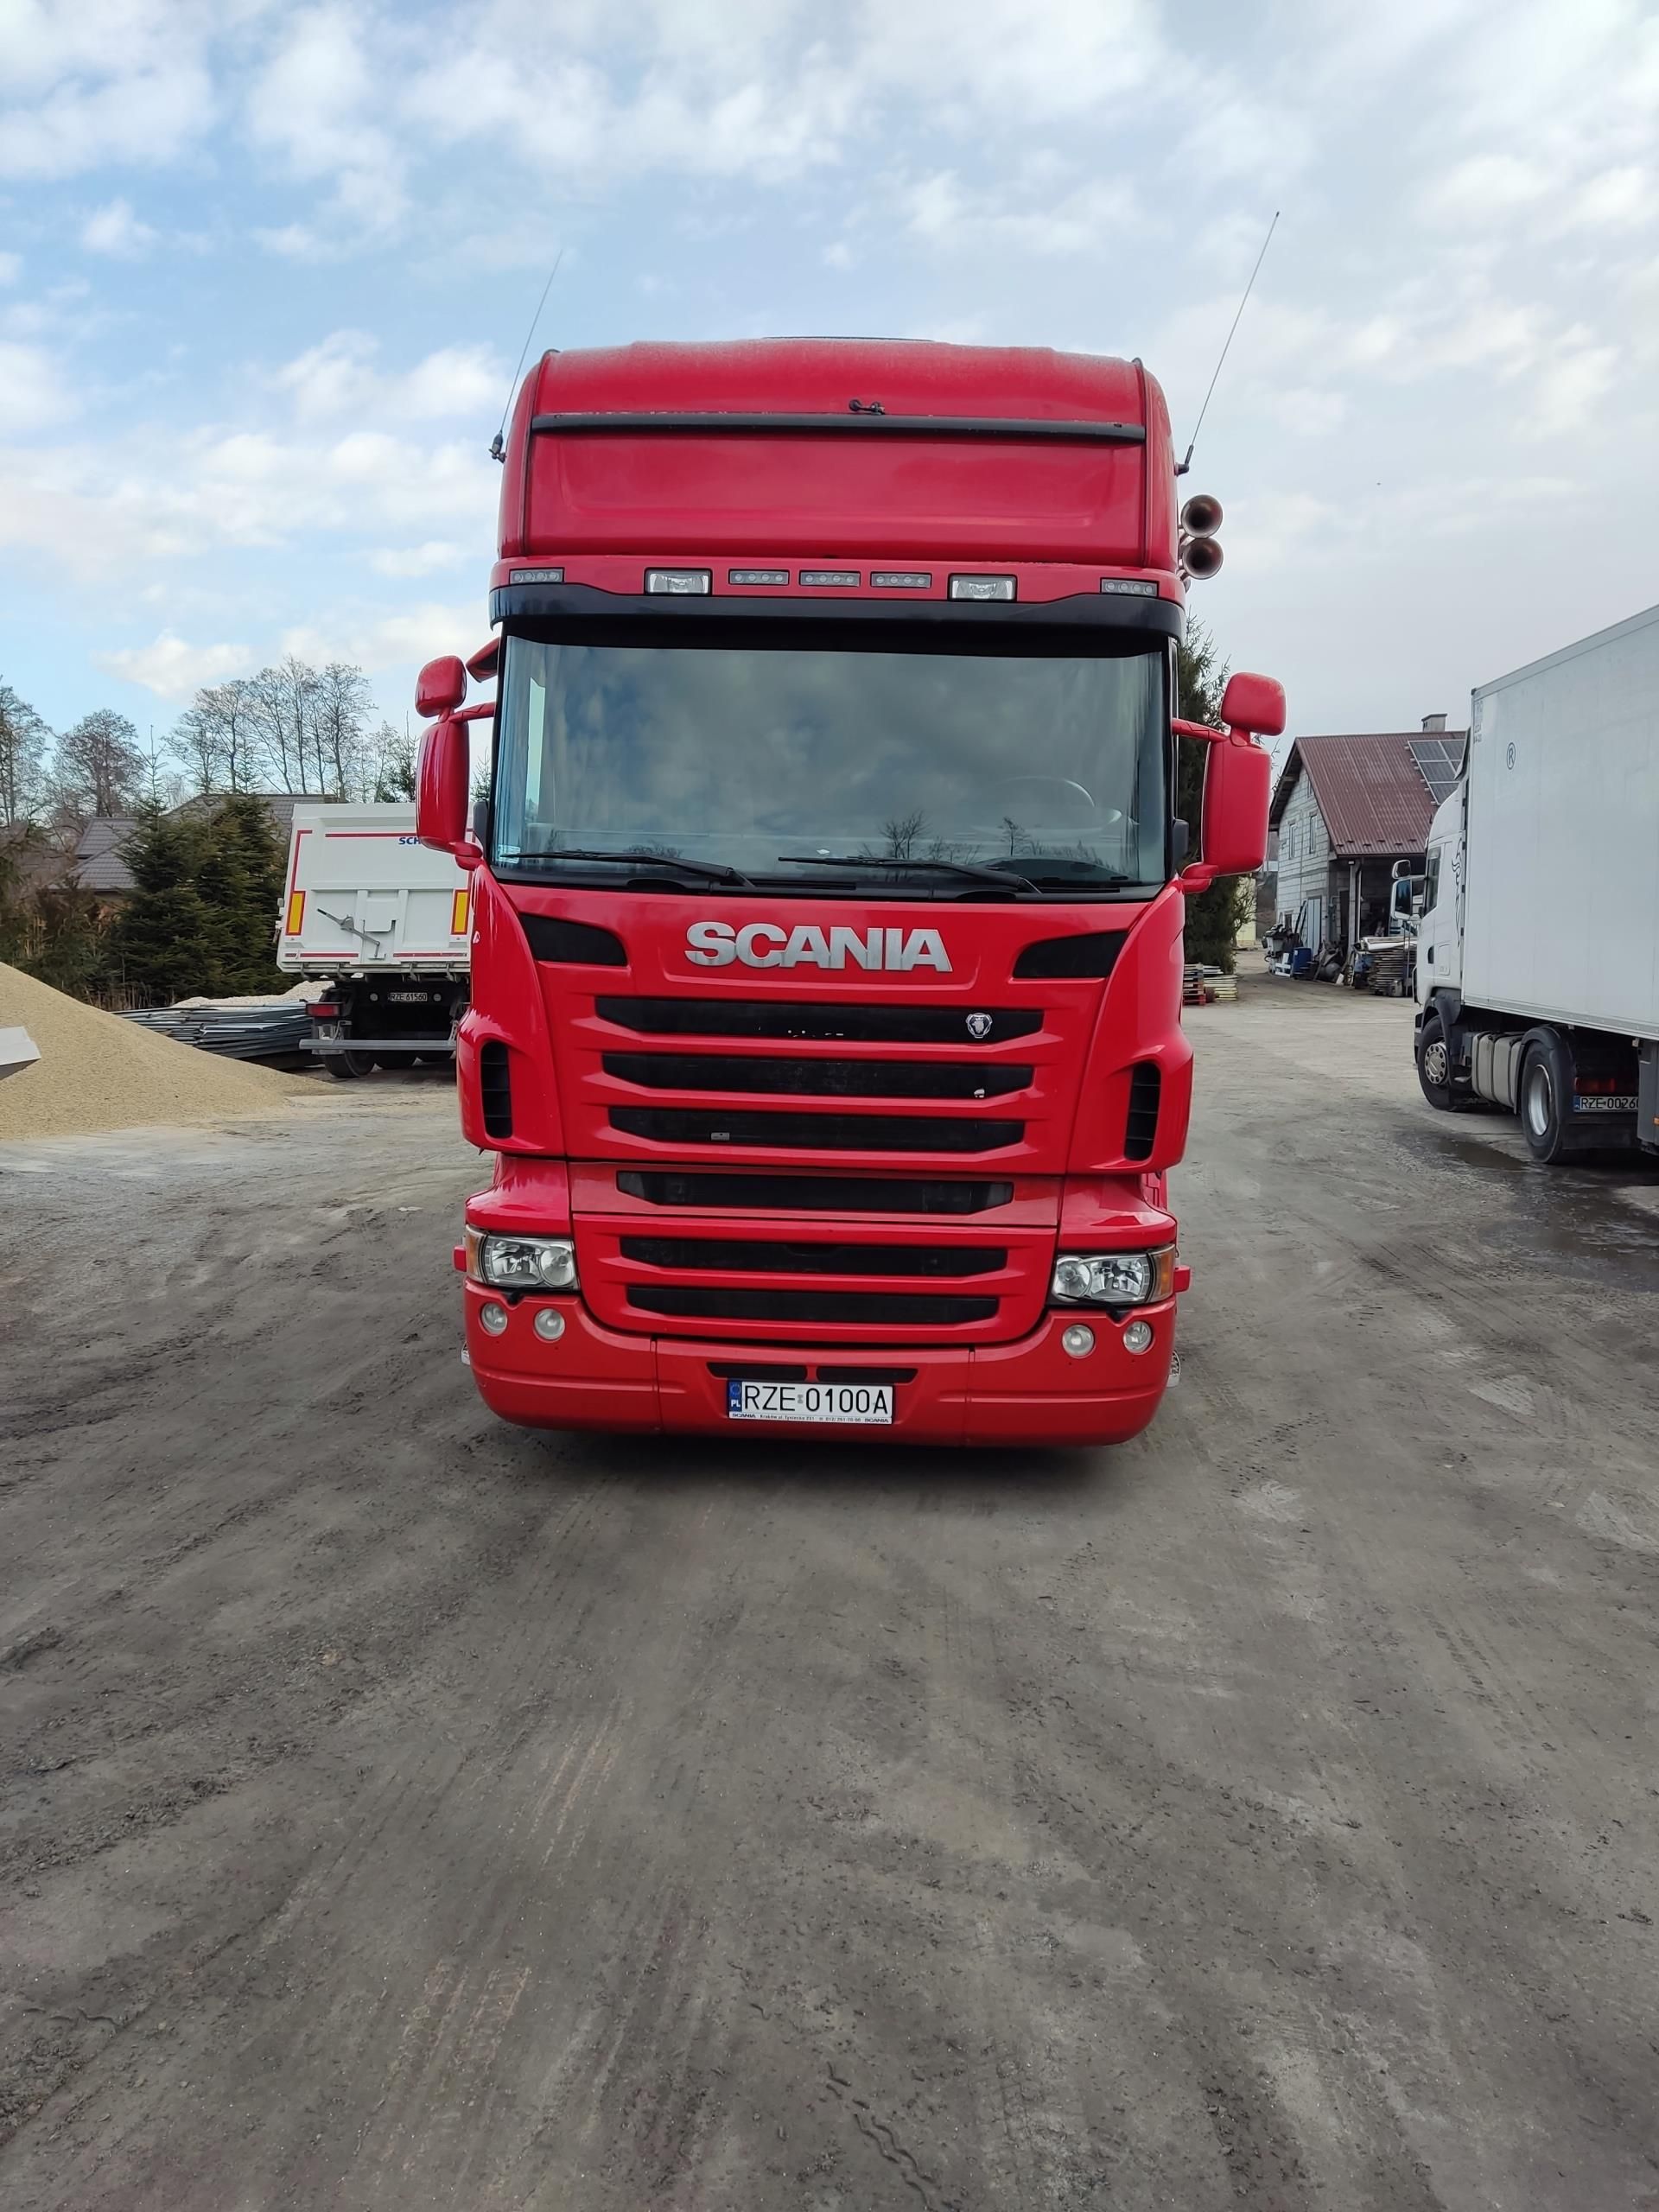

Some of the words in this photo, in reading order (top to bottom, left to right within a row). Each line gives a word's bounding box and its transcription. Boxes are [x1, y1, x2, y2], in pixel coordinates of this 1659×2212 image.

[398, 836, 422, 845] SCH
[683, 921, 953, 972] SCANIA
[1581, 1097, 1604, 1109] RZE
[731, 1399, 741, 1408] PL
[744, 1385, 796, 1411] RZE
[805, 1388, 888, 1414] 0100A
